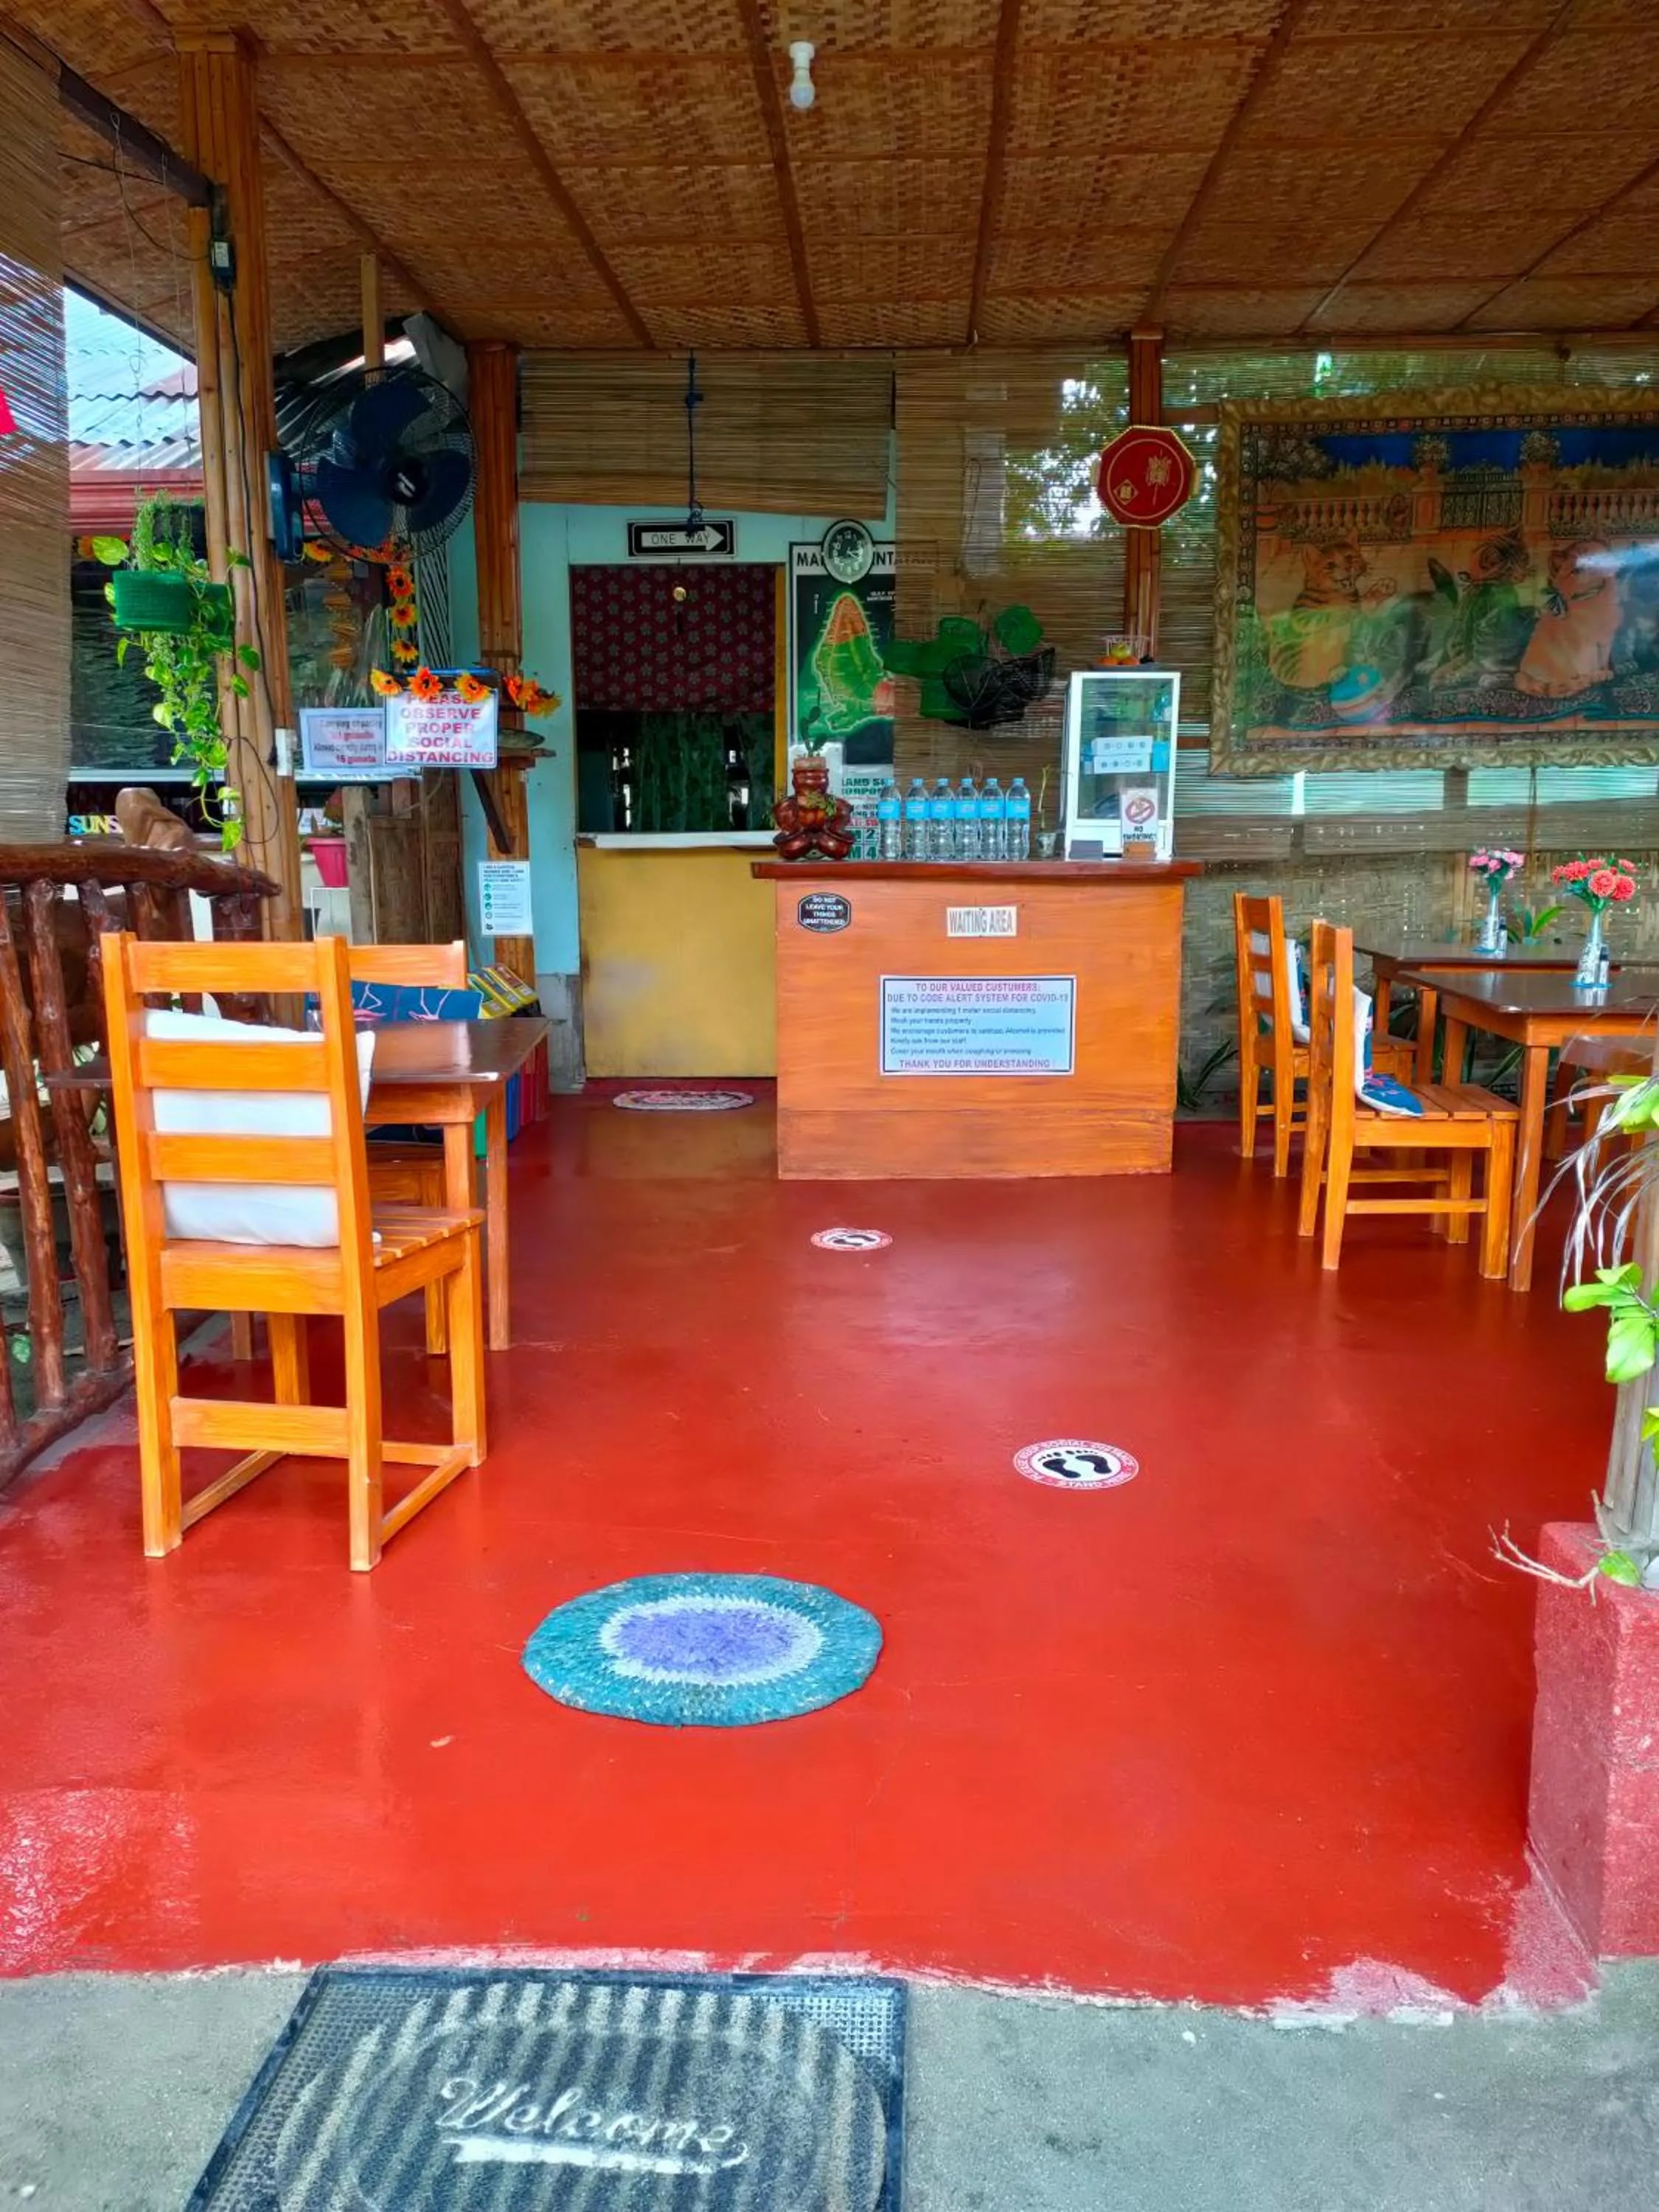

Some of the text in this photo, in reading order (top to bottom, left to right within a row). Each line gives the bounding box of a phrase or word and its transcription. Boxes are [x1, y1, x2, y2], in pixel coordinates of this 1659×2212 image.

[651, 532, 710, 544] ONE WAY
[400, 708, 481, 719] OBSERVE
[406, 723, 476, 734] PROPER
[406, 737, 473, 748] SOCIAL
[387, 751, 493, 762] DISTANCING
[950, 910, 1013, 933] WAITING AREA
[916, 983, 927, 992] TO
[930, 983, 947, 992] OUR
[950, 983, 983, 992] VALUED
[887, 993, 905, 1002] DUE
[907, 993, 918, 1002] TO
[920, 993, 944, 1002] CODE
[946, 993, 973, 1002] ALERT
[975, 993, 1008, 1002] SYSTEM
[1011, 993, 1028, 1002] FOR
[900, 1059, 1051, 1068] THANK YOU FOR UNDERSTANDING
[436, 2076, 740, 2154] Welcome
